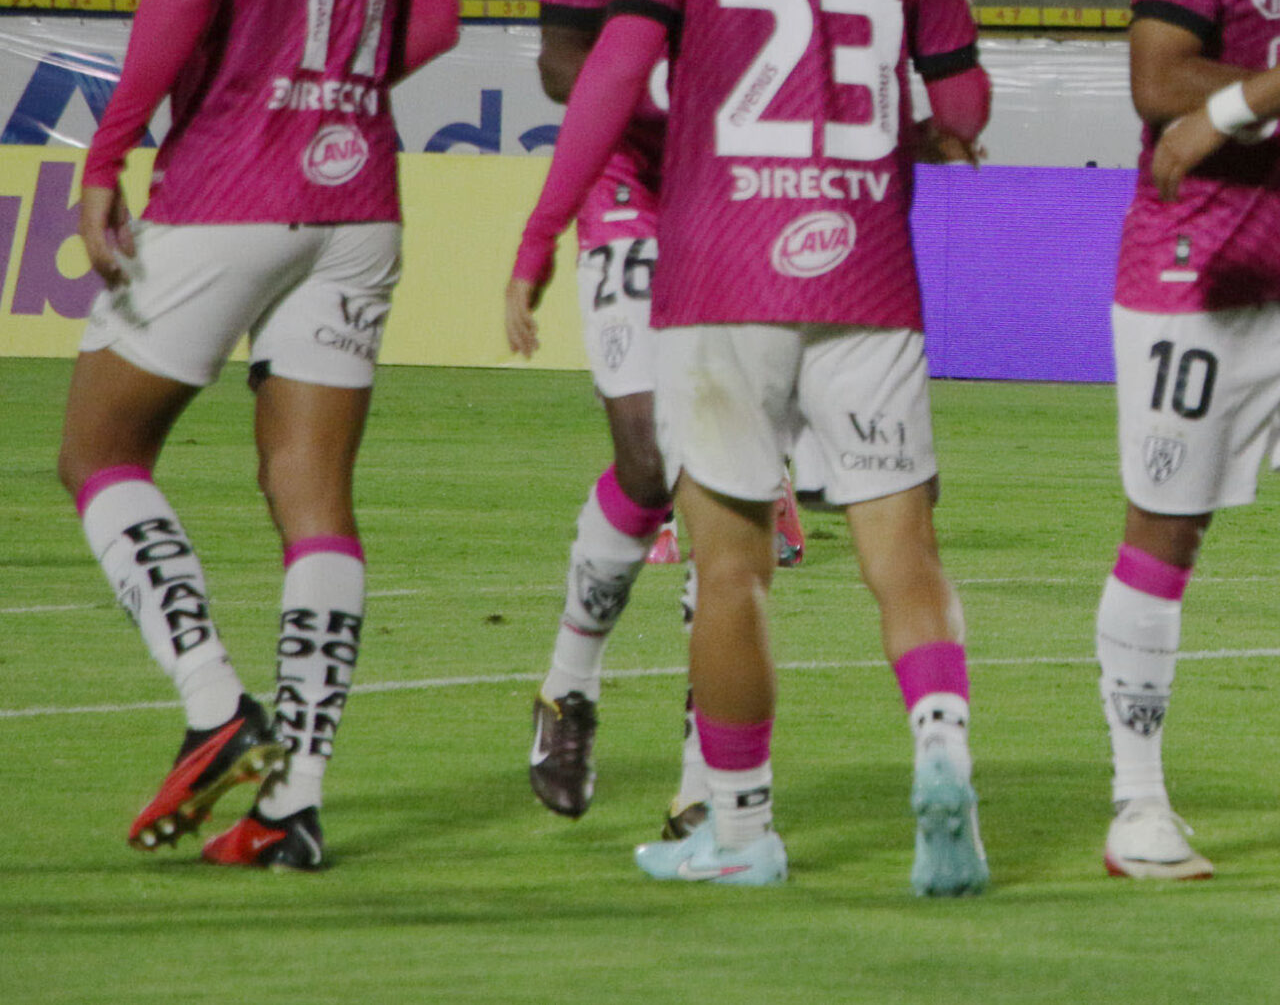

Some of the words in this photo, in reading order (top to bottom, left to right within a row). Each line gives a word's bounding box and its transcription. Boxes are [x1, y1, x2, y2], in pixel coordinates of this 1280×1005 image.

[730, 165, 891, 202] DIRECTV
[588, 237, 657, 311] 26
[780, 226, 852, 257] LAVA
[1150, 339, 1219, 420] 10
[122, 517, 211, 659] ROLAND
